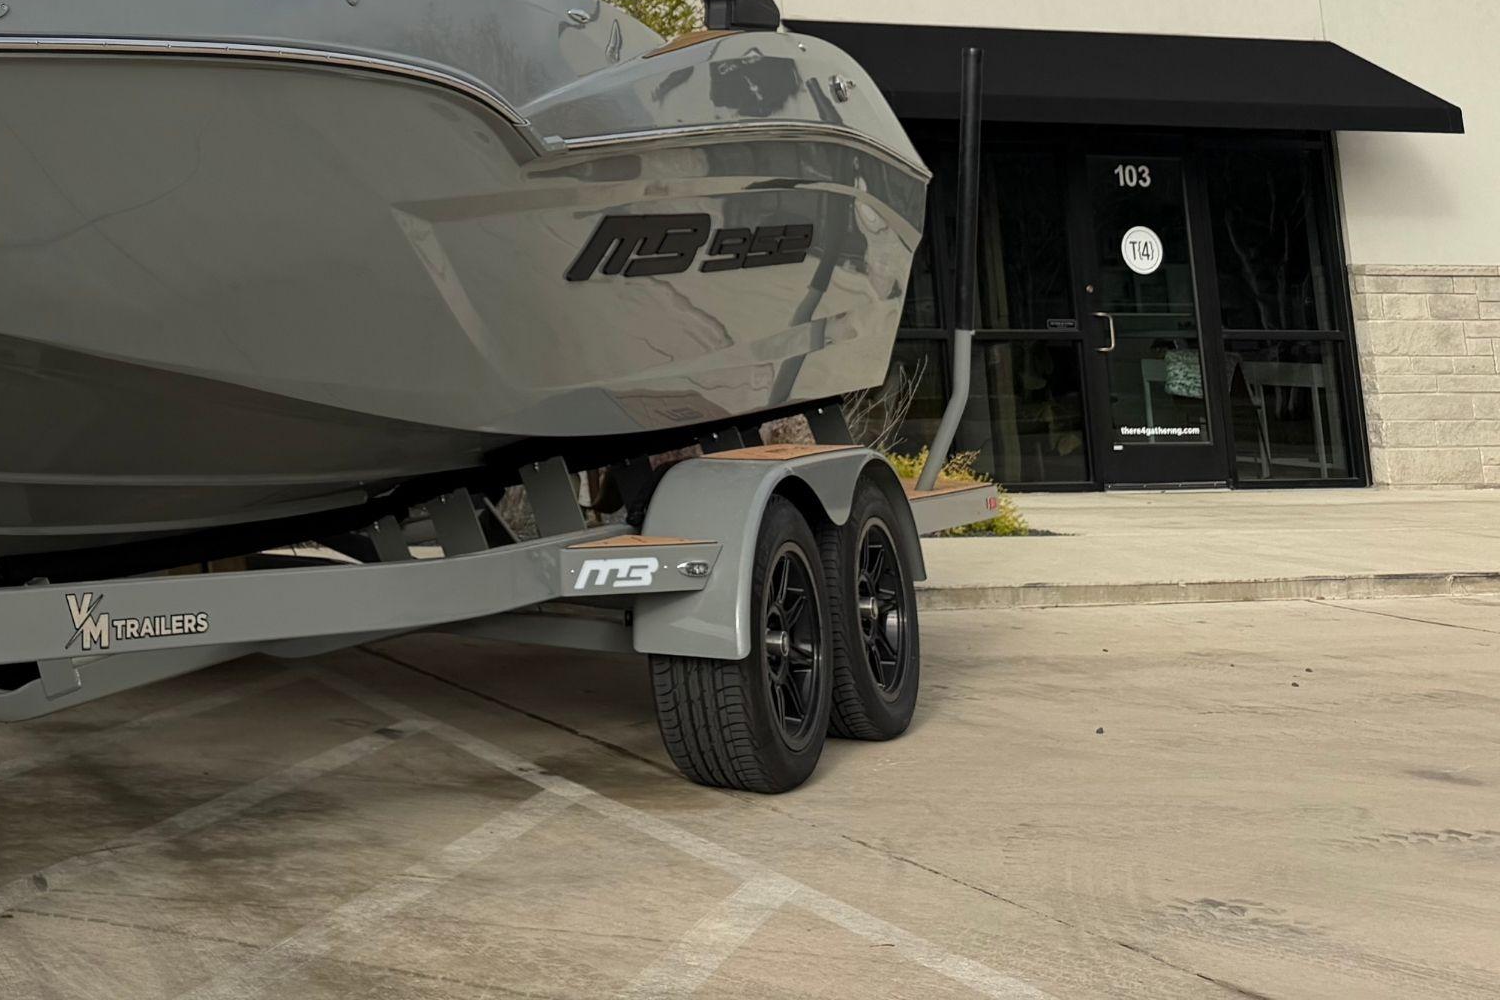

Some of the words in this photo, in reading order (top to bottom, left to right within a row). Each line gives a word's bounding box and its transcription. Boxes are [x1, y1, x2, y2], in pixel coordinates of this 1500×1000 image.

[1114, 164, 1151, 187] 103
[700, 224, 814, 272] 952
[112, 611, 209, 640] TRAILERS
